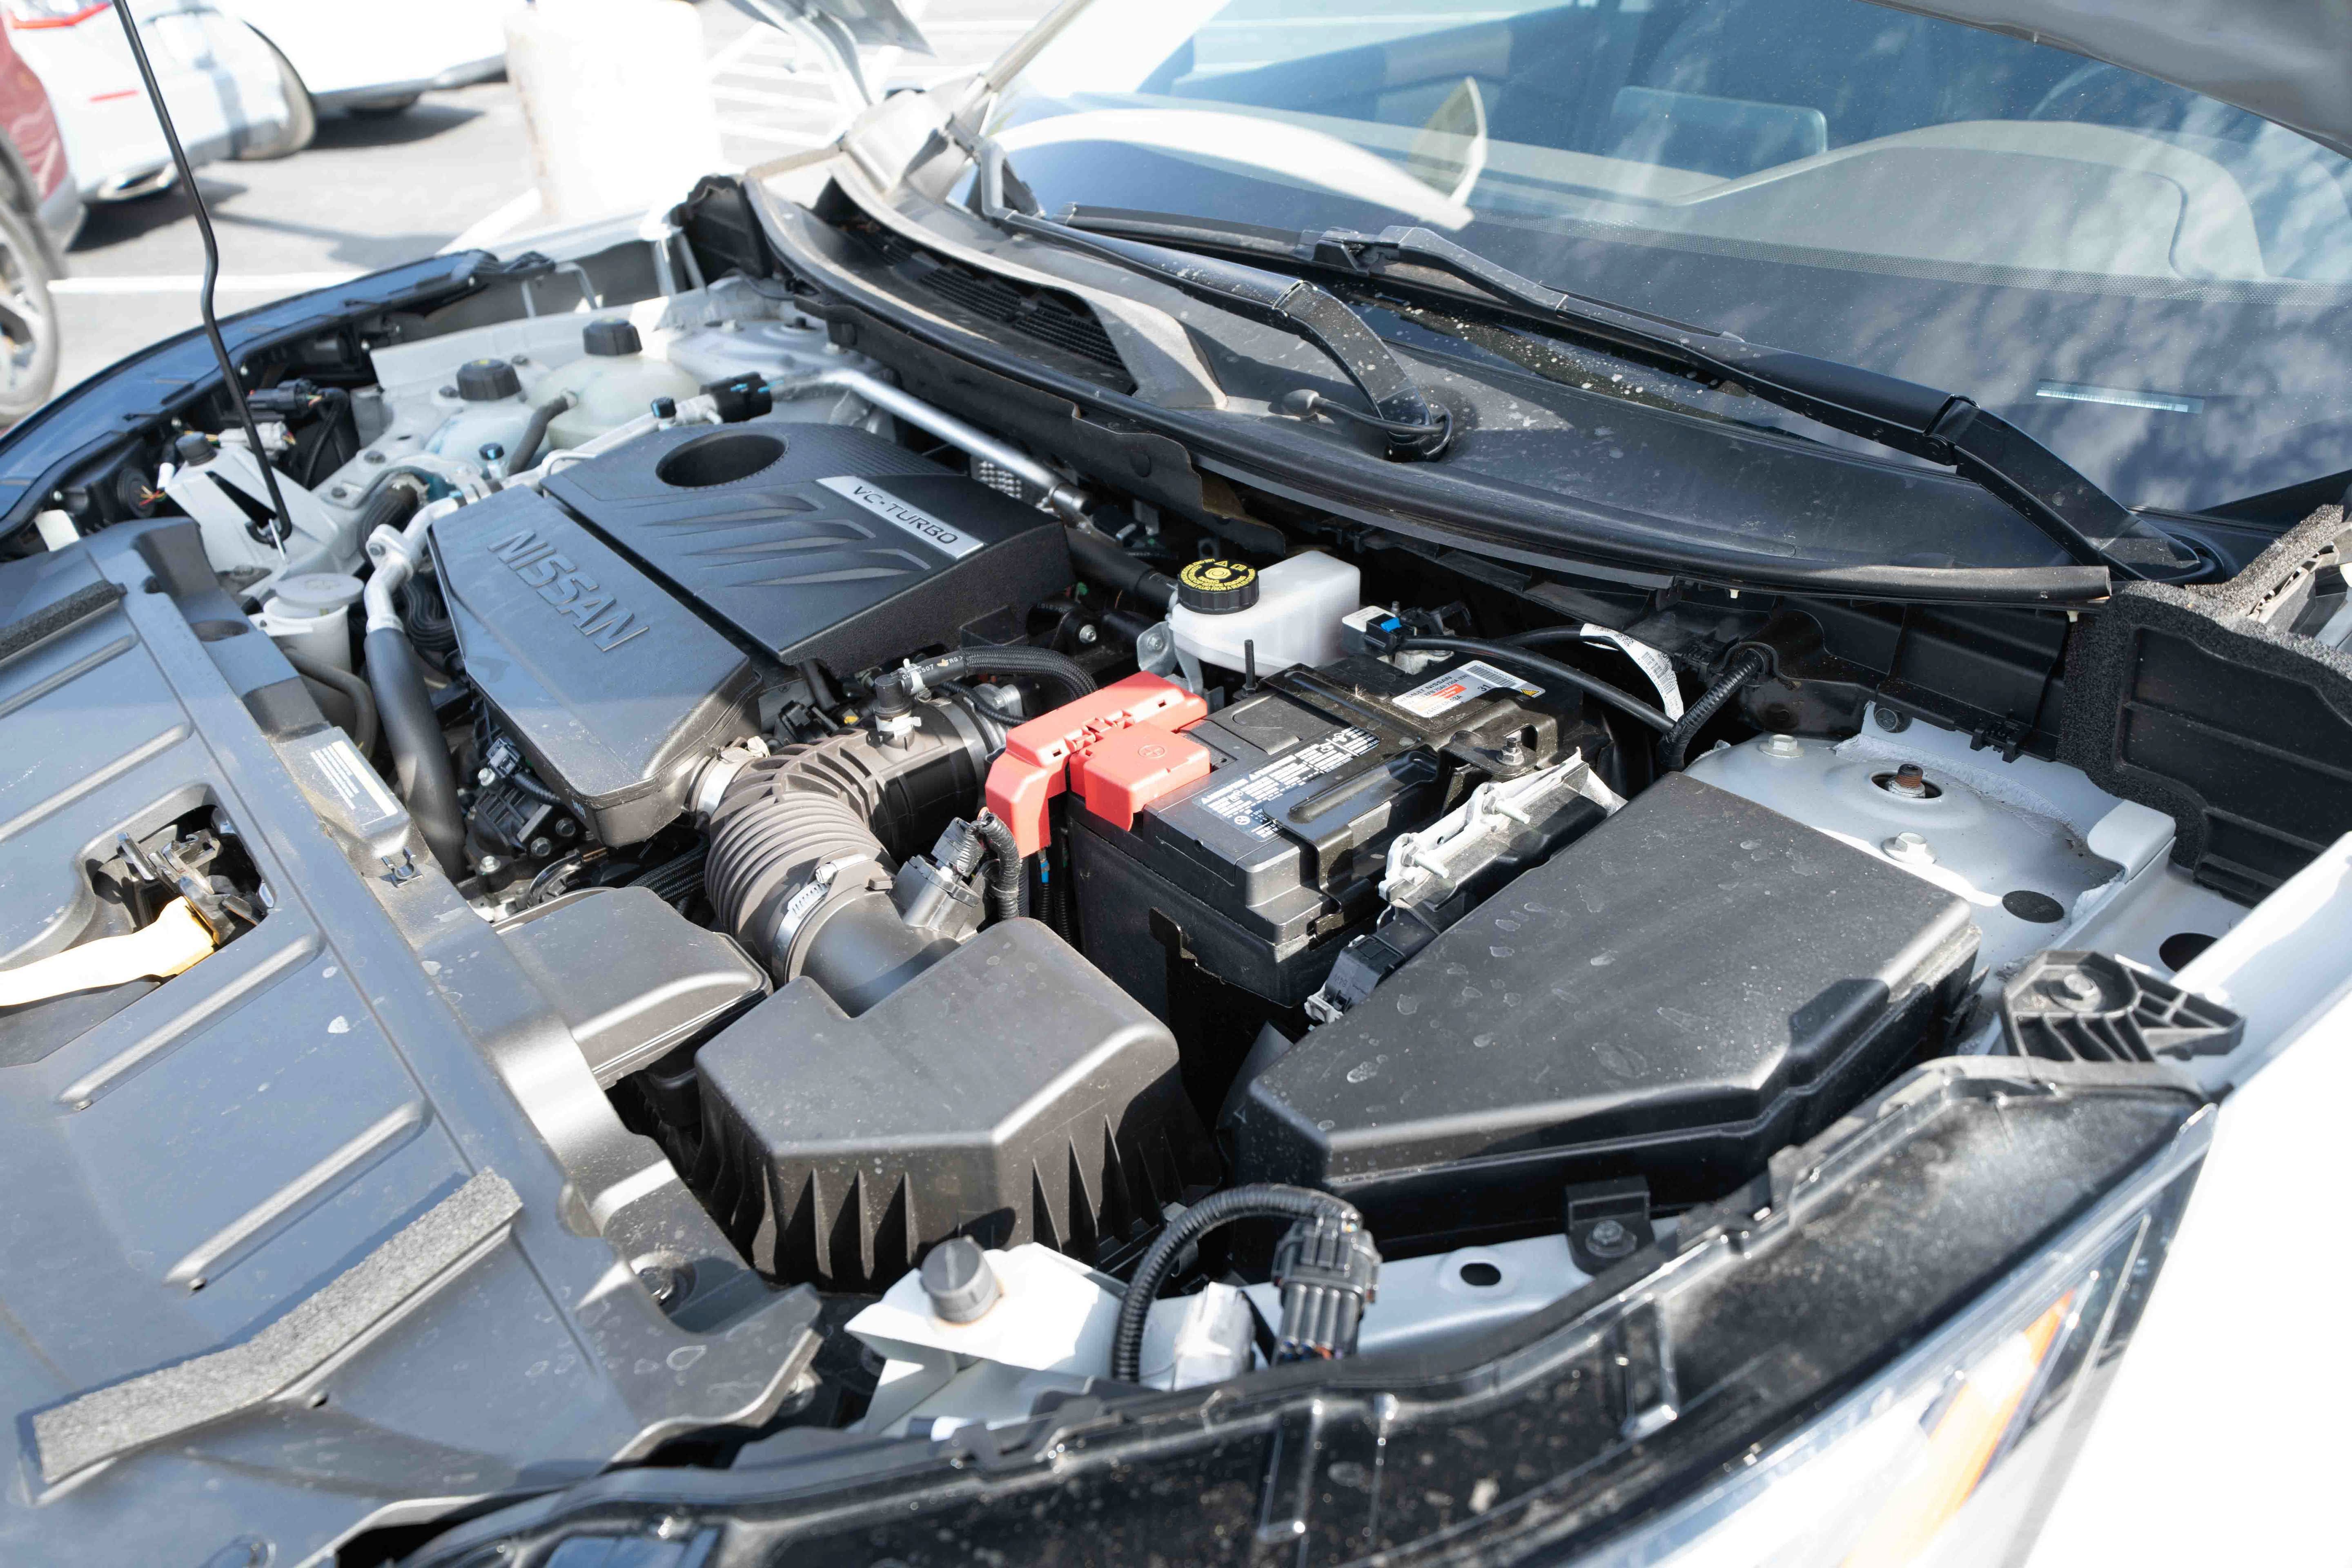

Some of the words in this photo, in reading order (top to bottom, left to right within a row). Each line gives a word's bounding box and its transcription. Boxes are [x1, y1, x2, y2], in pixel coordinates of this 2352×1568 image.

[487, 530, 650, 653] NISSAN
[1425, 676, 1452, 690] NISSAN
[1477, 684, 1491, 692] 31
